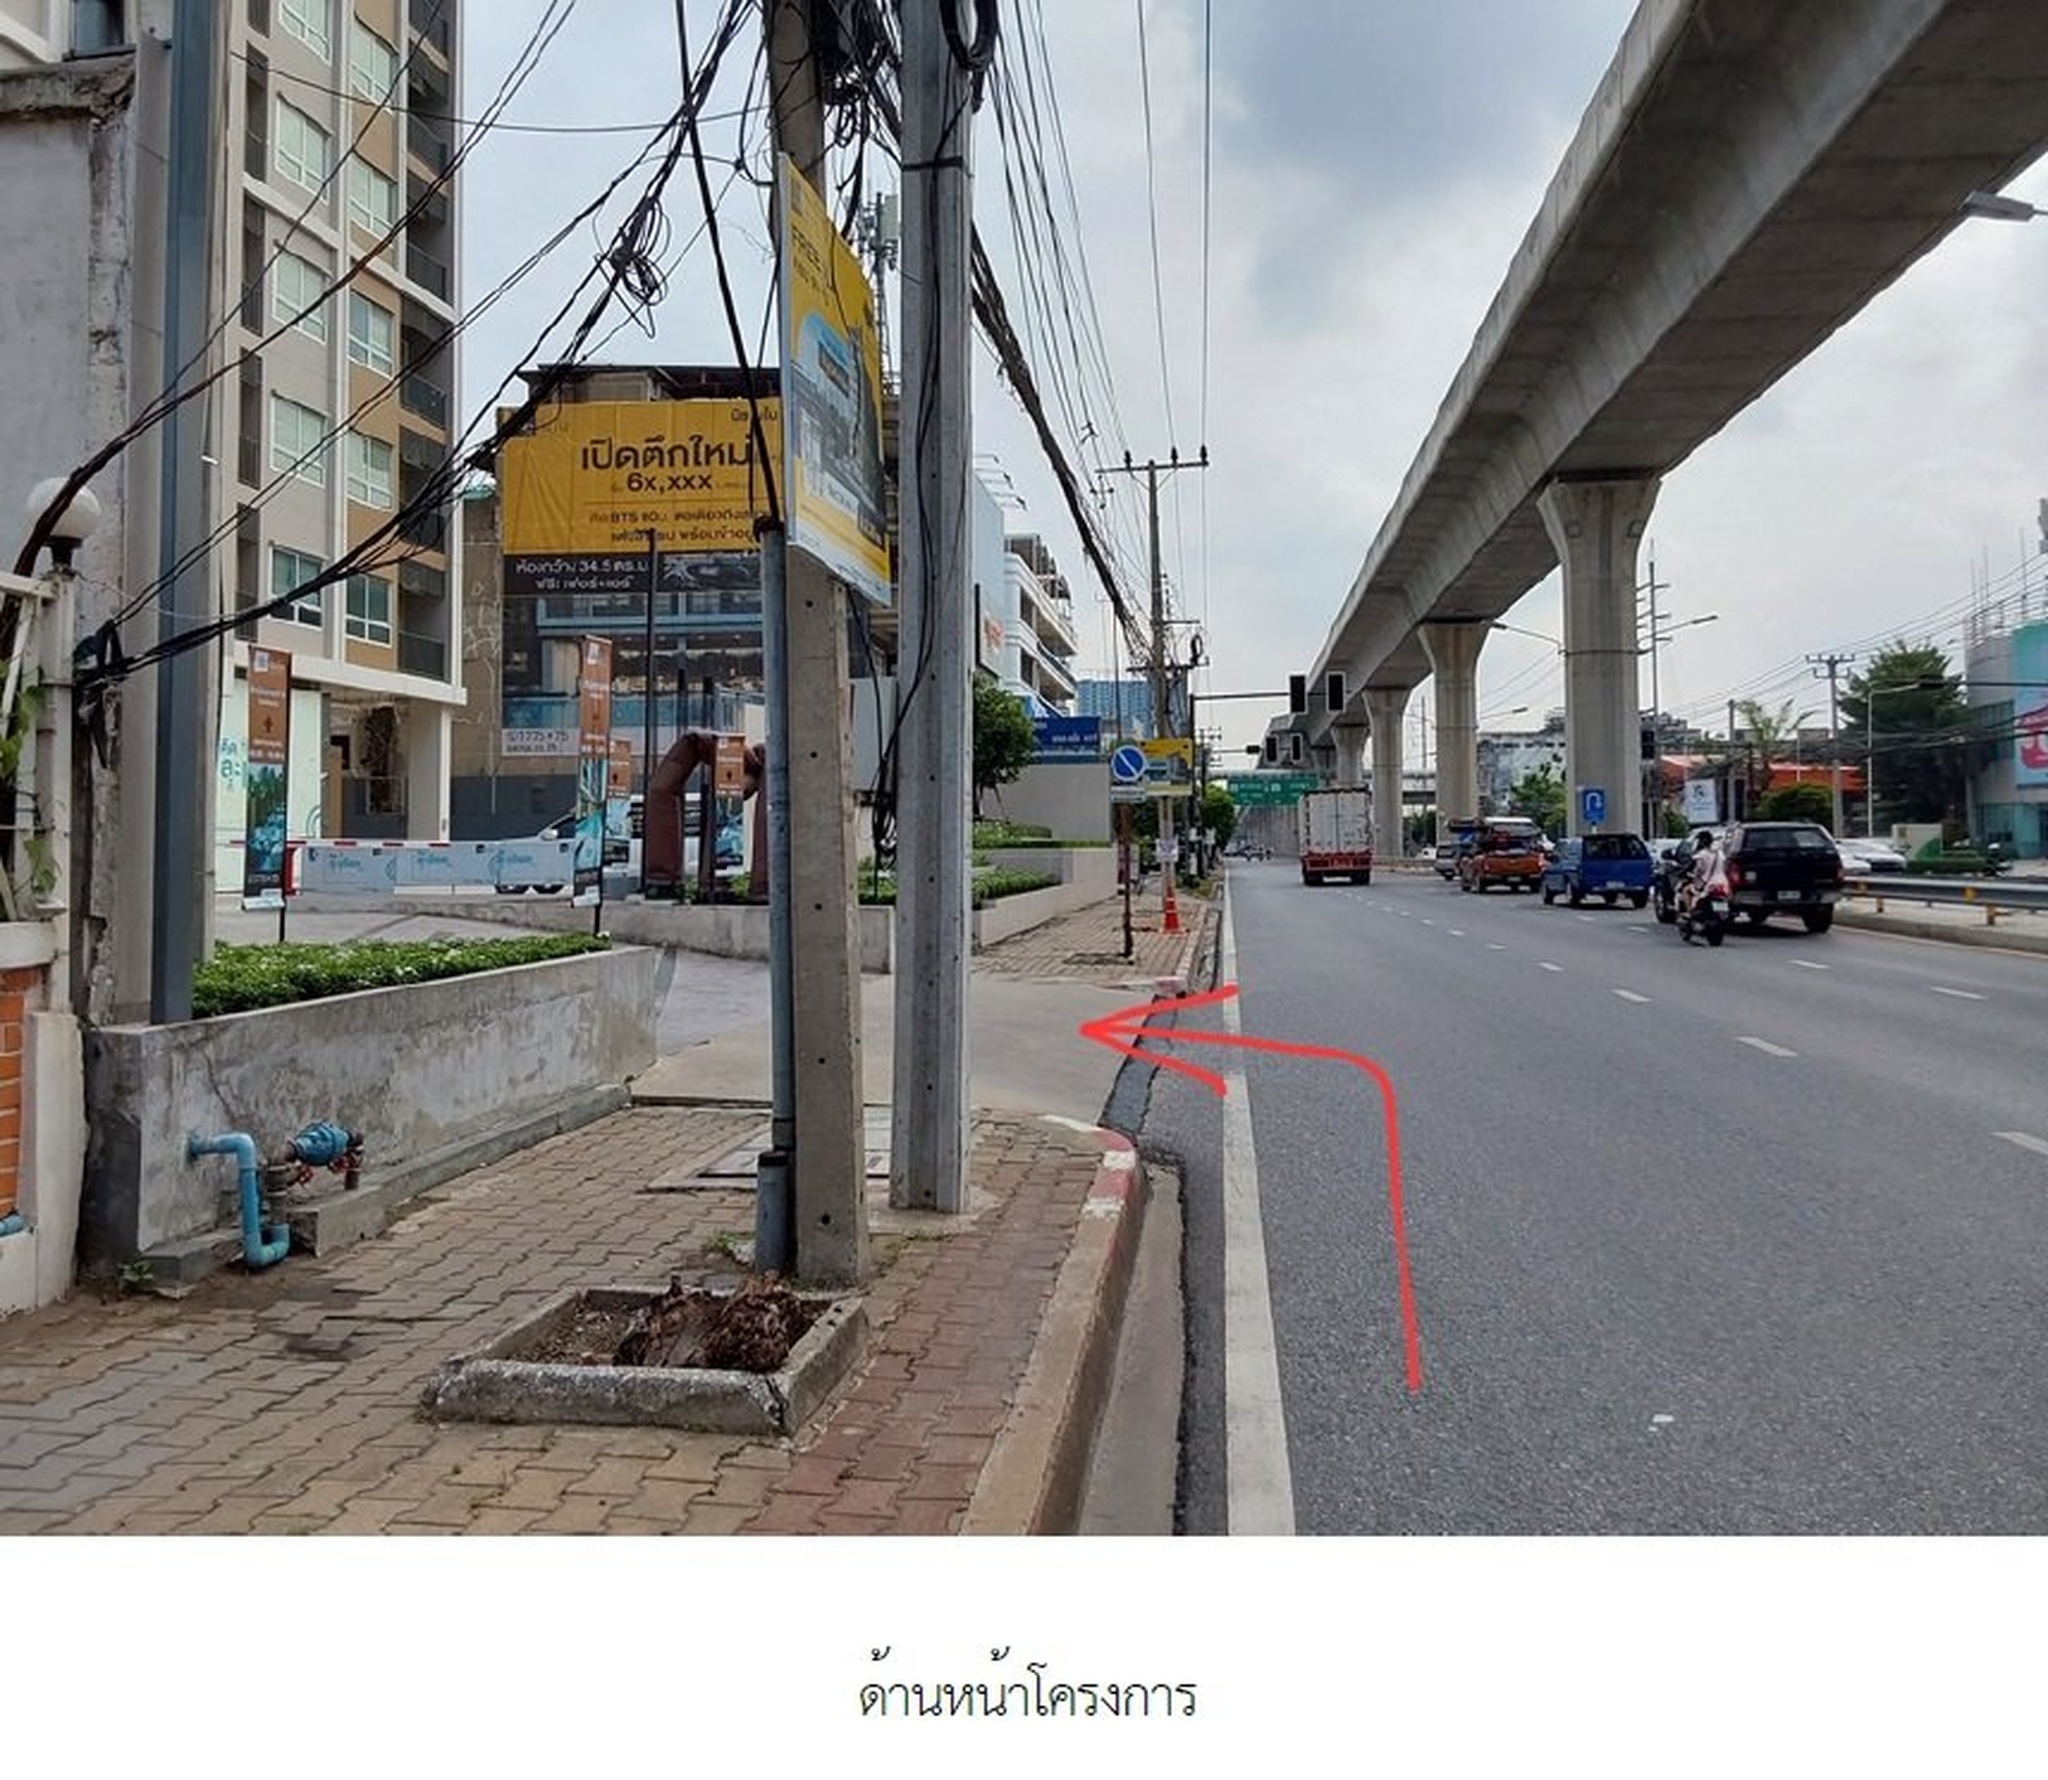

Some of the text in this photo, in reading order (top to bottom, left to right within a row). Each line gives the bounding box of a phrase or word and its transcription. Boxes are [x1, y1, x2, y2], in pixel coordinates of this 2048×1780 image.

[582, 434, 751, 470] เปิดตึกใหม่
[627, 472, 712, 495] 6x,xxx
